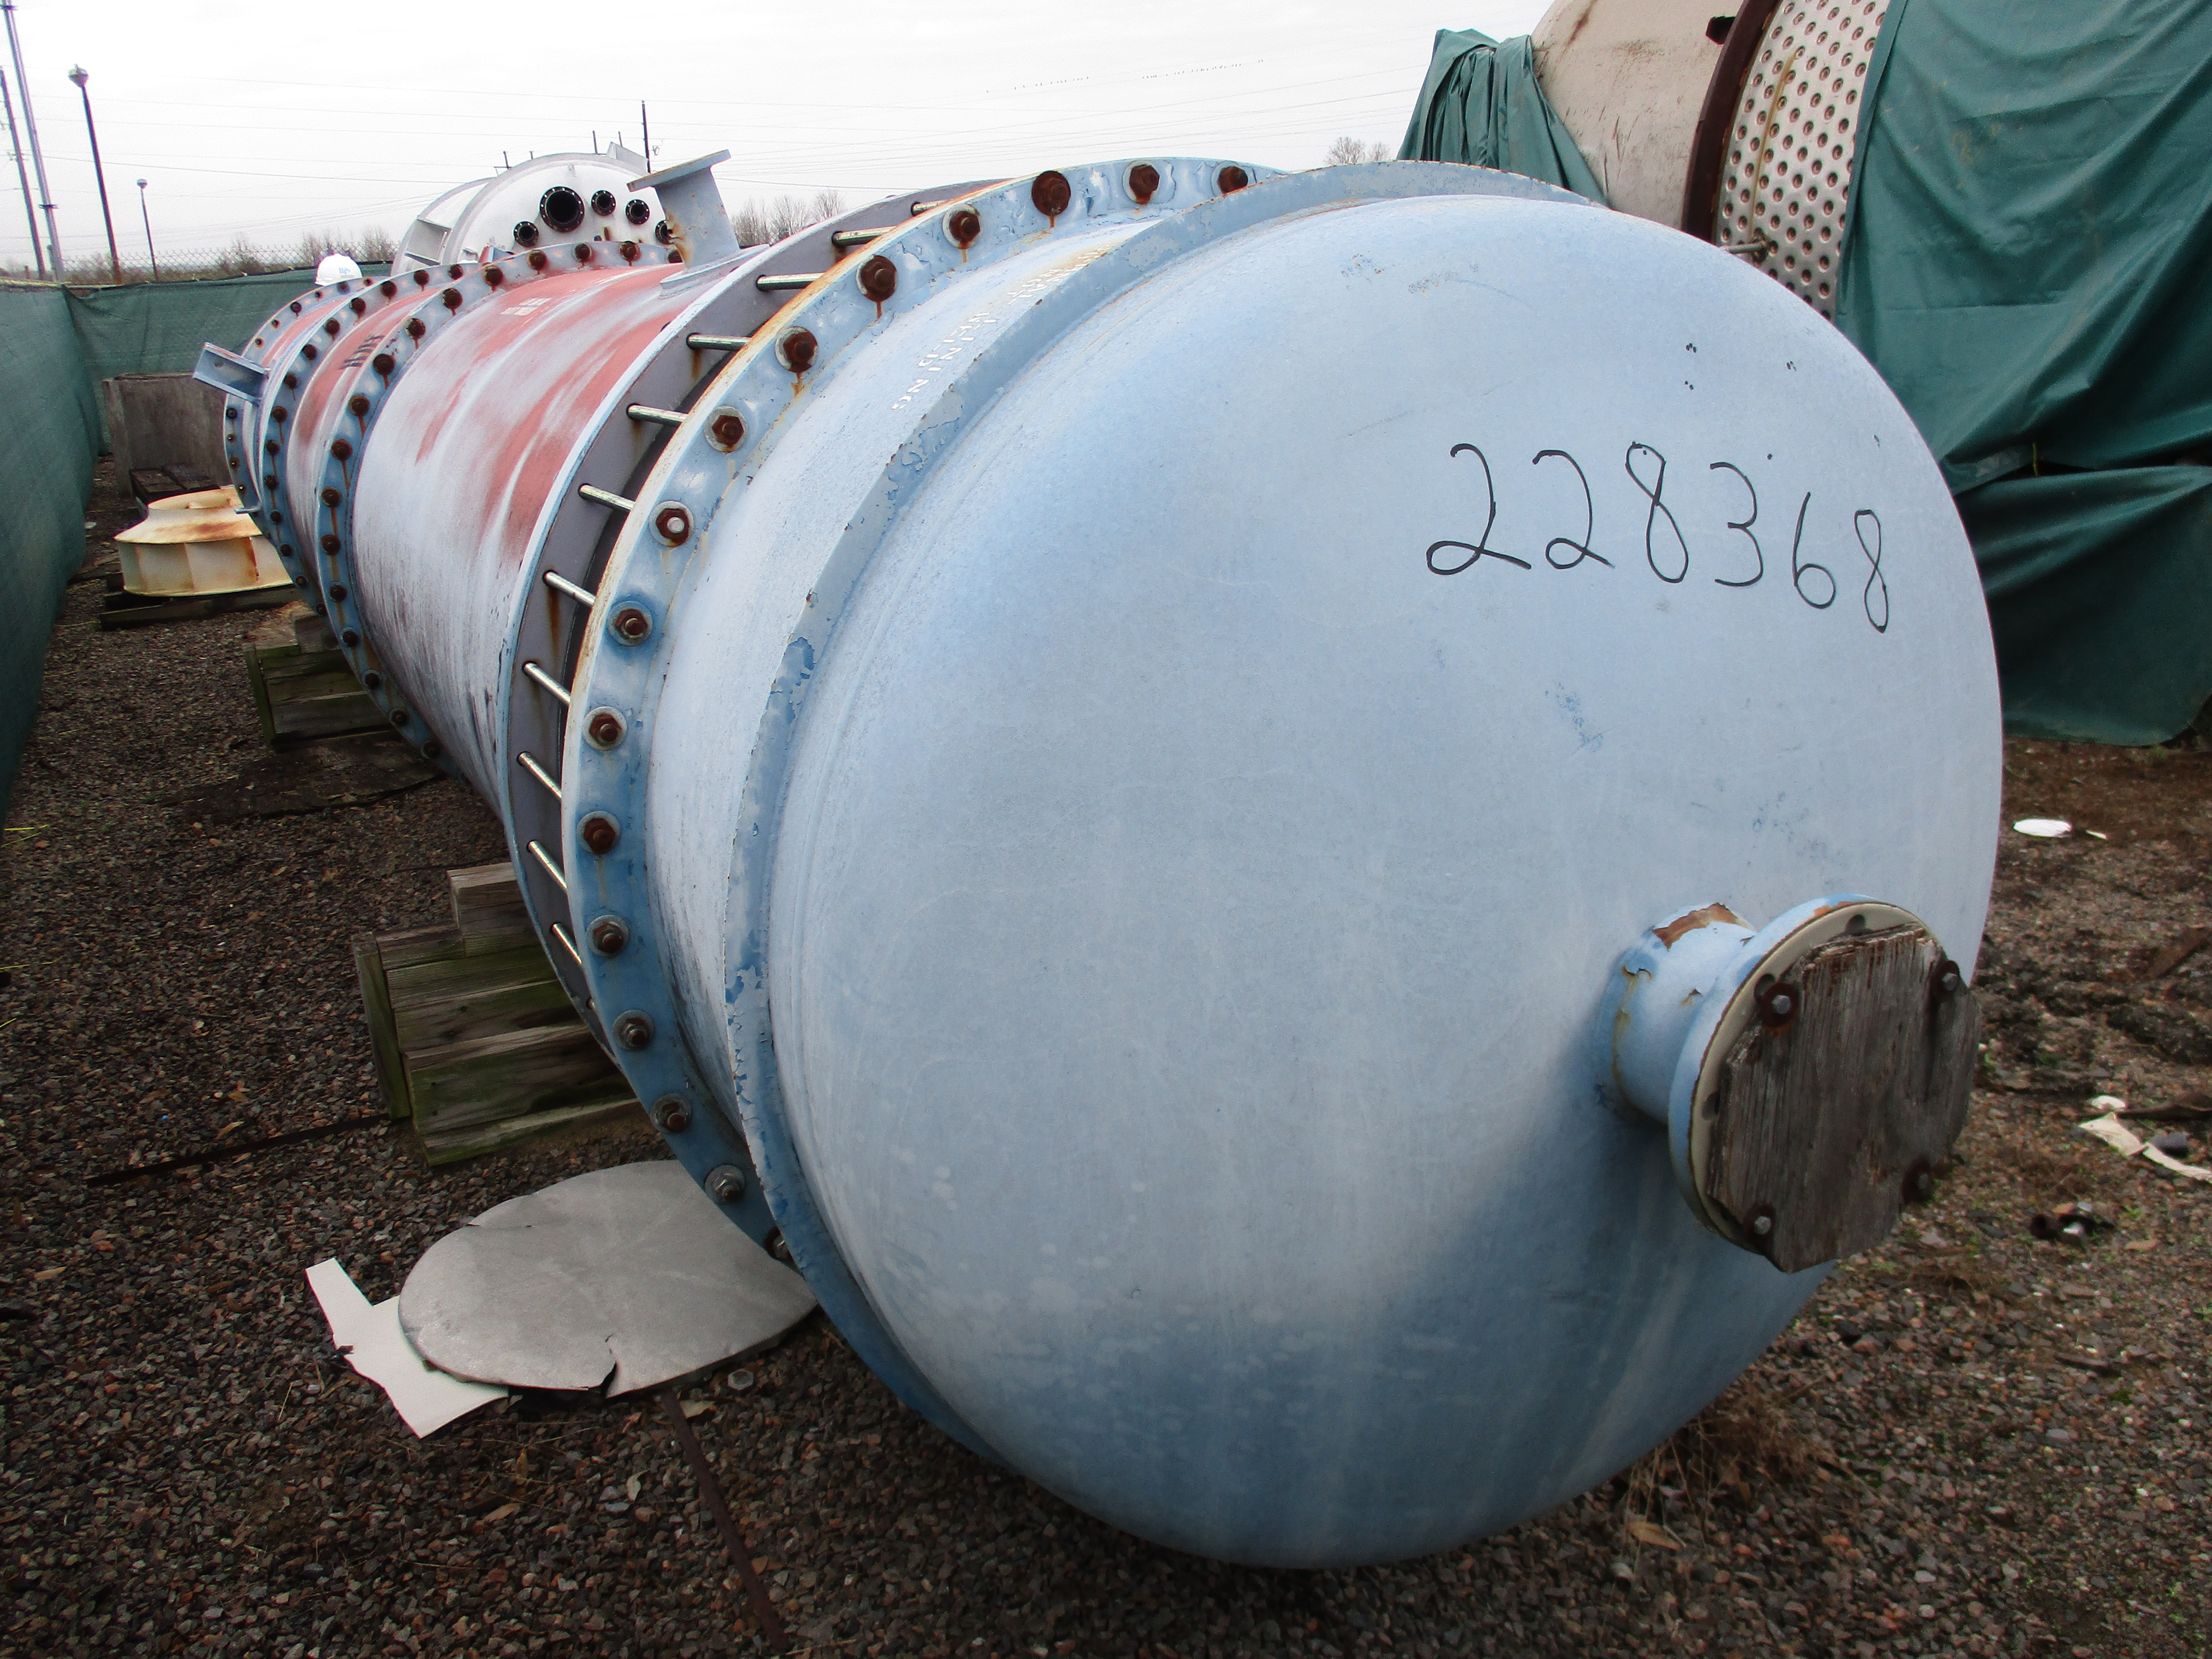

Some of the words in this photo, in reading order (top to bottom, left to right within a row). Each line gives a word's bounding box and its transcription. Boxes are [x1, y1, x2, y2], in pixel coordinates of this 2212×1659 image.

[1007, 269, 1063, 298] NOT
[891, 319, 997, 409] LINING
[918, 312, 990, 367] WELD
[1427, 442, 1889, 633] 228368
